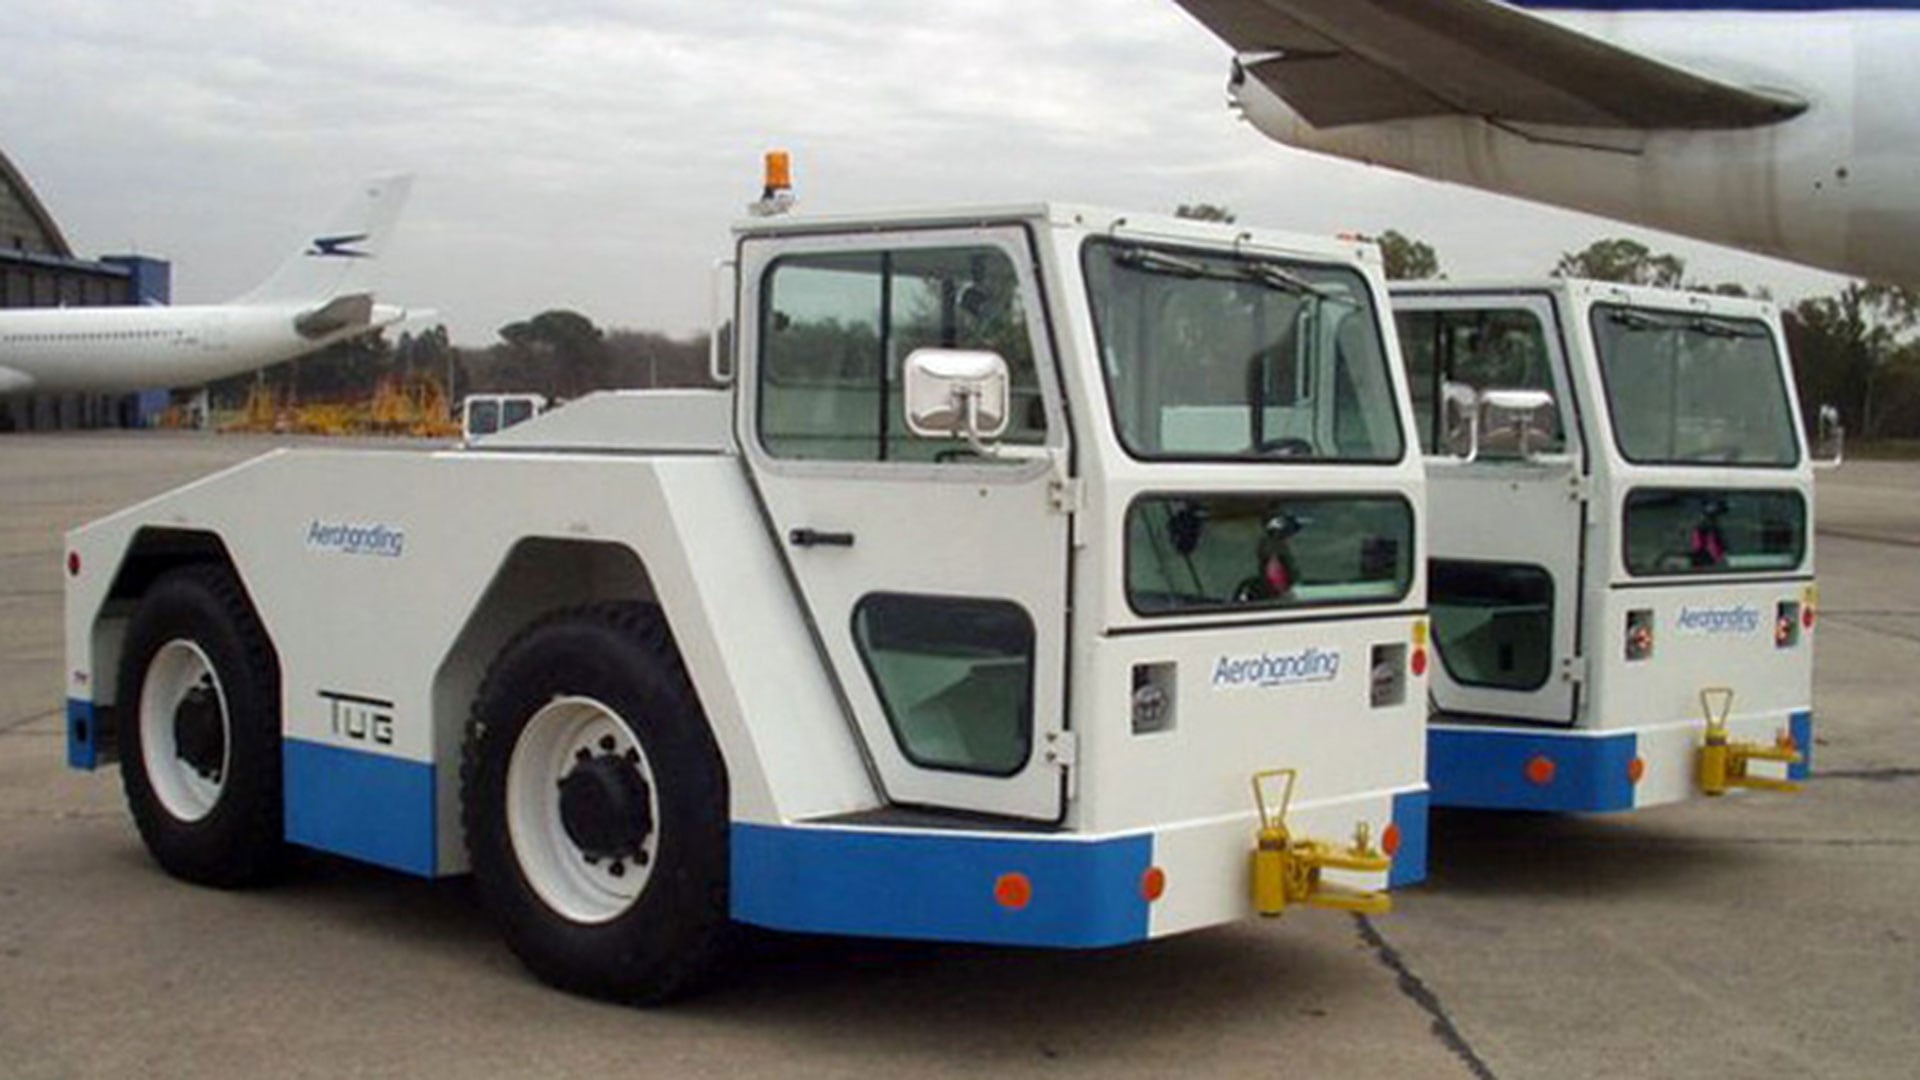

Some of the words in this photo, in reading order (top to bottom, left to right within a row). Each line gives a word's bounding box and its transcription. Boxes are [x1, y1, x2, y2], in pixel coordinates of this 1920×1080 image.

[307, 519, 404, 557] Aerohandling
[1213, 649, 1340, 686] Aerohandling
[317, 690, 395, 745] TUG
